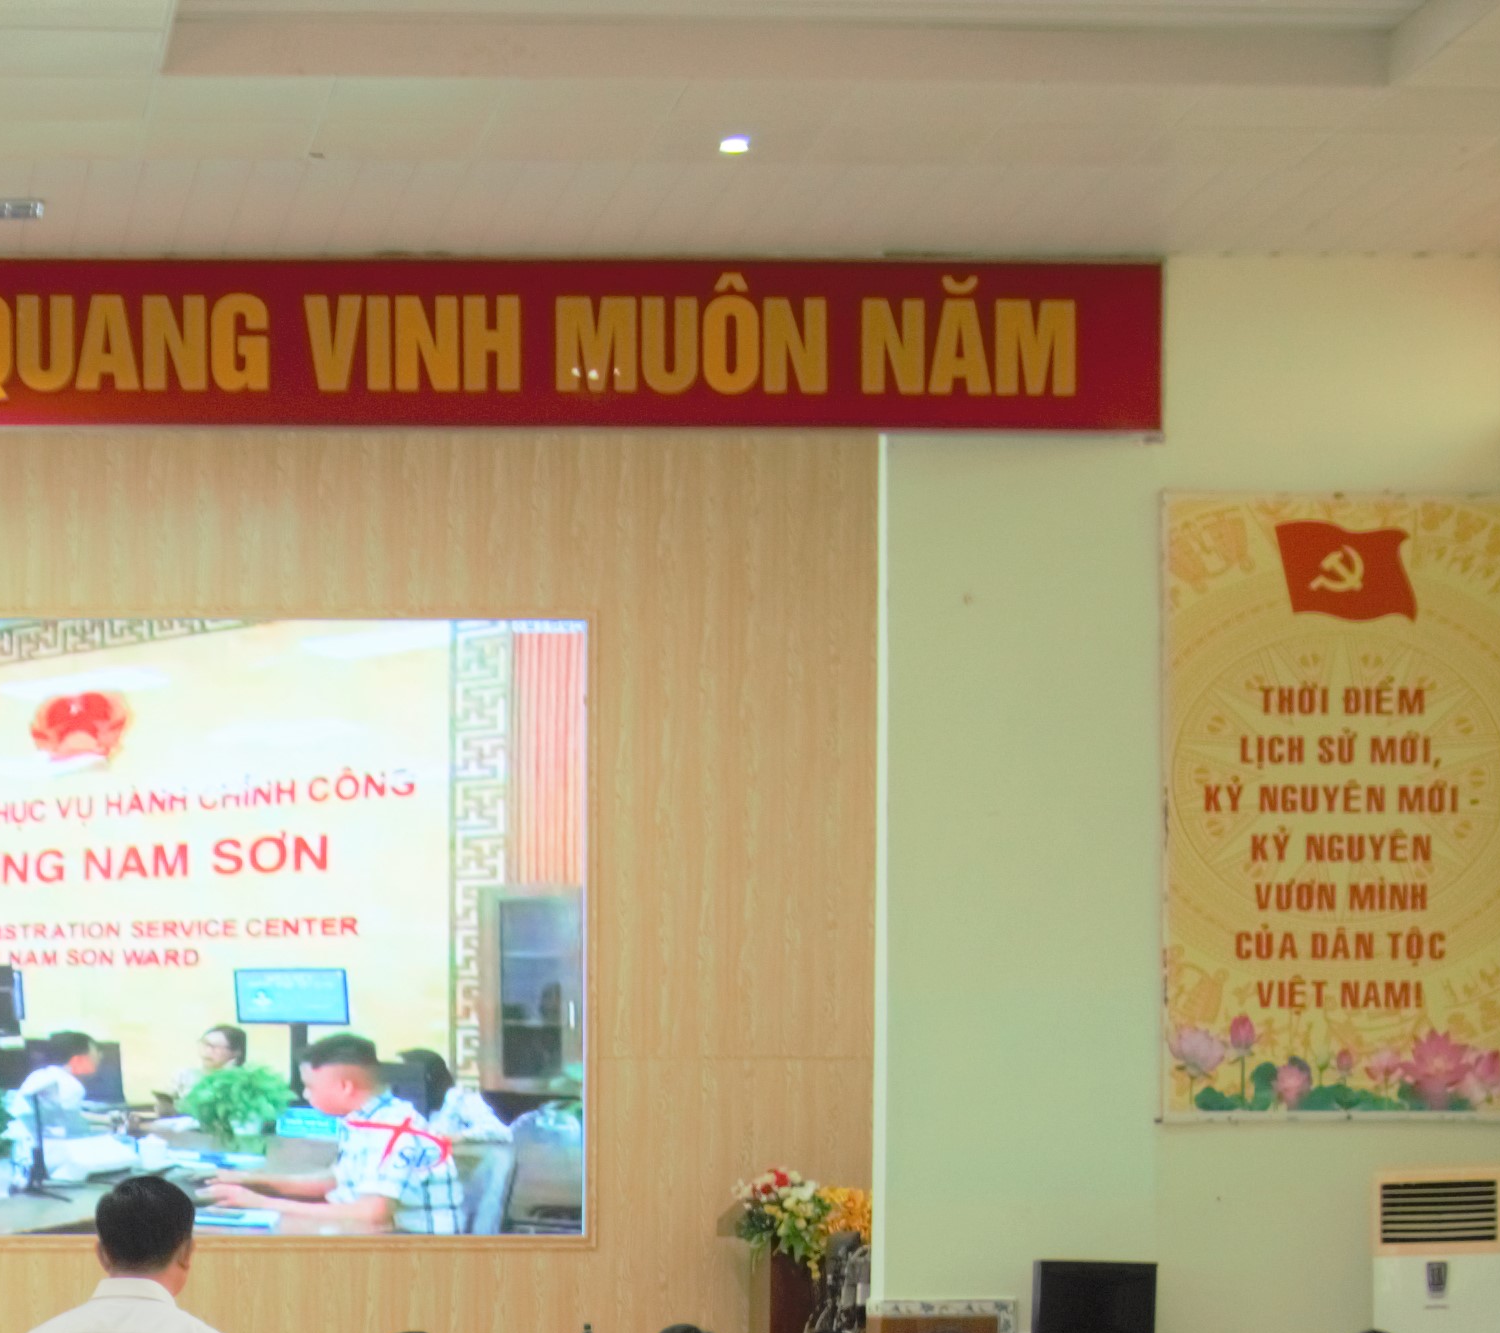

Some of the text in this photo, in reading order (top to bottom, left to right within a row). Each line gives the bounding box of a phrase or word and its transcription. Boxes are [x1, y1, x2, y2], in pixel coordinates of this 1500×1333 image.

[302, 294, 522, 393] VINH
[555, 271, 827, 395] MUÔN
[861, 275, 1077, 396] NĂM
[1257, 675, 1426, 717] THỜI ĐIỂM
[1239, 735, 1305, 770] LỊCH
[1317, 727, 1357, 765] SỬ
[55, 796, 95, 828] VỤ
[1203, 775, 1244, 814] KỶ
[1258, 779, 1386, 814] NGUYÊN
[1398, 779, 1461, 813] MỚI
[83, 840, 190, 881] NAM
[212, 829, 329, 876] SƠN
[1250, 824, 1433, 863] KỶ NGUYÊN
[1255, 877, 1429, 912] VƯƠN MÌNH
[130, 918, 240, 940] SERVICE
[245, 916, 360, 938] CENTER
[1234, 922, 1447, 967] CỦA DÂN TỘC
[9, 949, 58, 968] NAM
[66, 948, 114, 968] SON
[123, 947, 201, 968] WARD
[1256, 974, 1328, 1016] VIỆT
